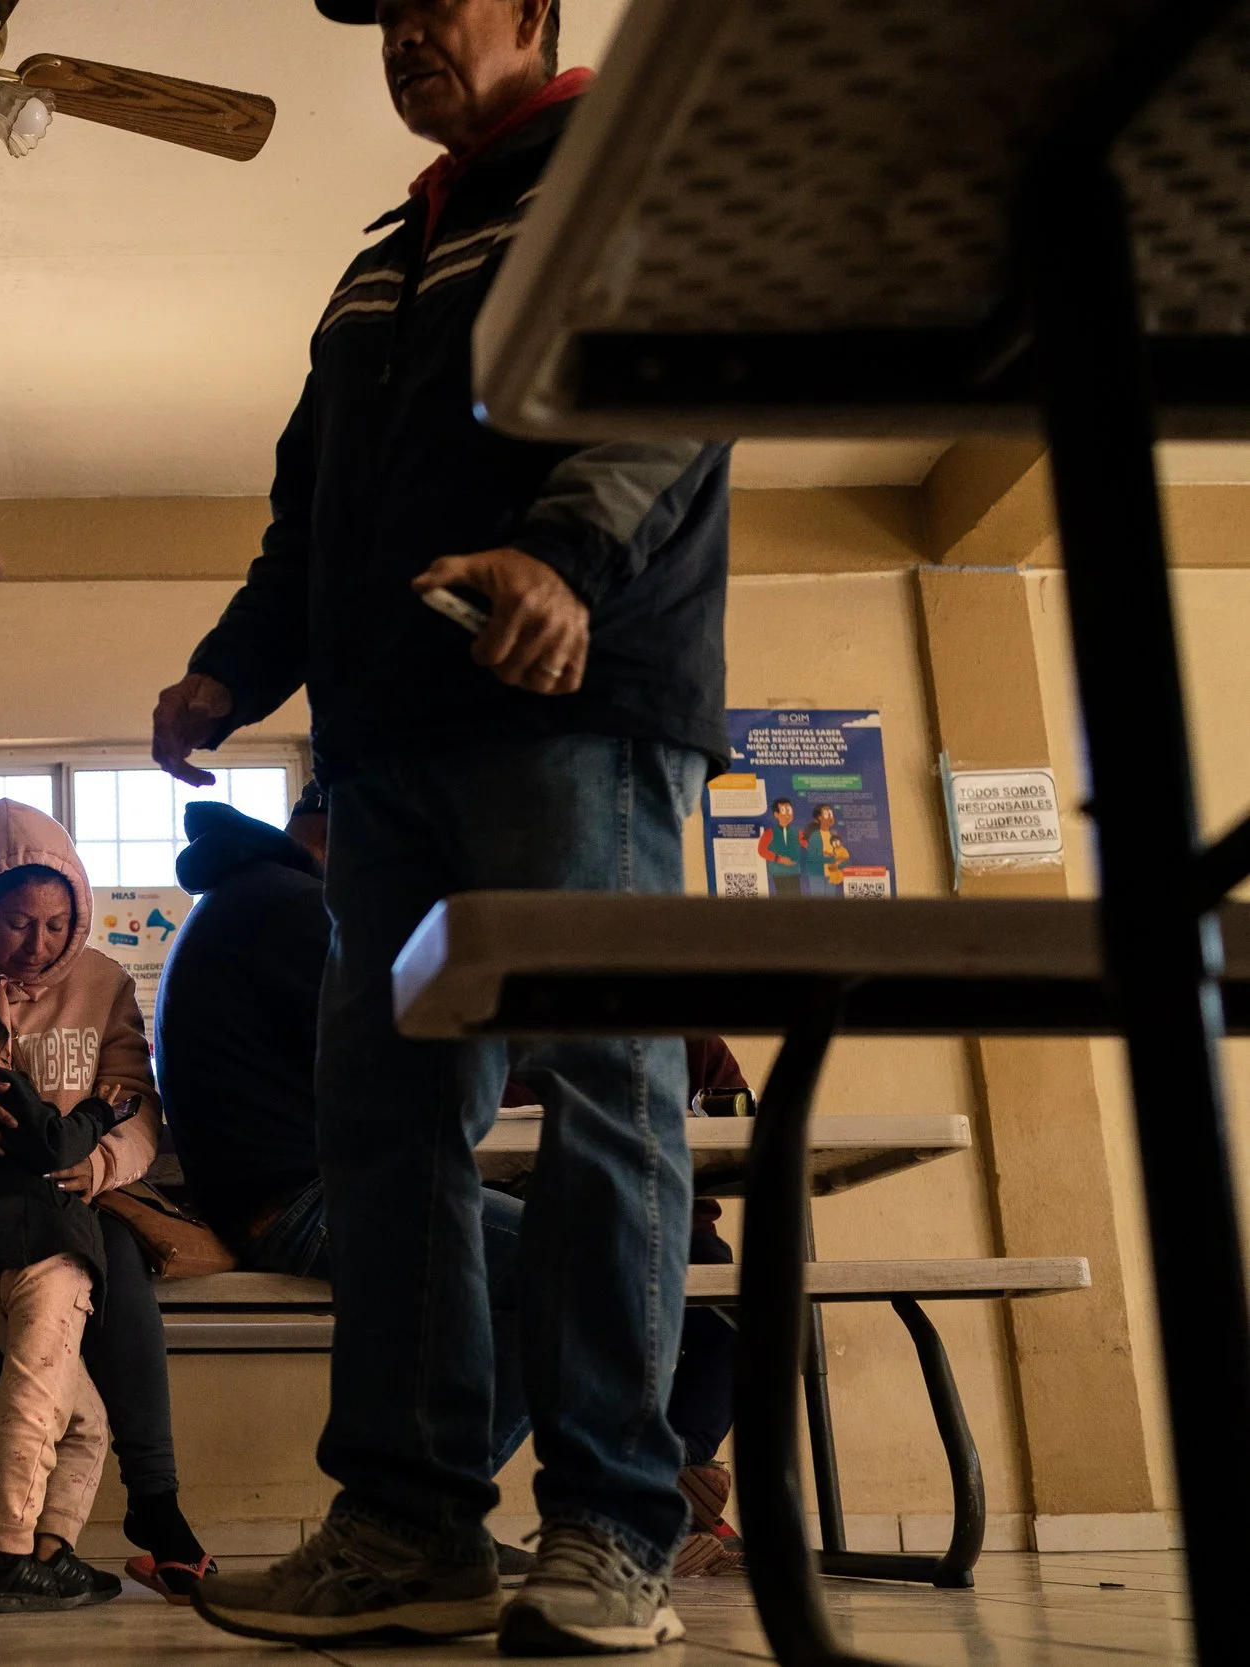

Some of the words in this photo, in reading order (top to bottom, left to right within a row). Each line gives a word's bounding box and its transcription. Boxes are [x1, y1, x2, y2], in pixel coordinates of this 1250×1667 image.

[789, 713, 810, 721] OIM
[836, 743, 848, 751] EN
[789, 758, 846, 767] EXTRANJERA?
[959, 787, 1000, 799] TODOS
[1002, 785, 1047, 797] SOMOS
[957, 799, 1053, 813] RESPONSABLES
[974, 815, 1041, 829] ¡CUIDEMOS
[961, 831, 1018, 843] NUESTRA
[1020, 828, 1058, 841] CASA!
[111, 891, 136, 901] HIAS
